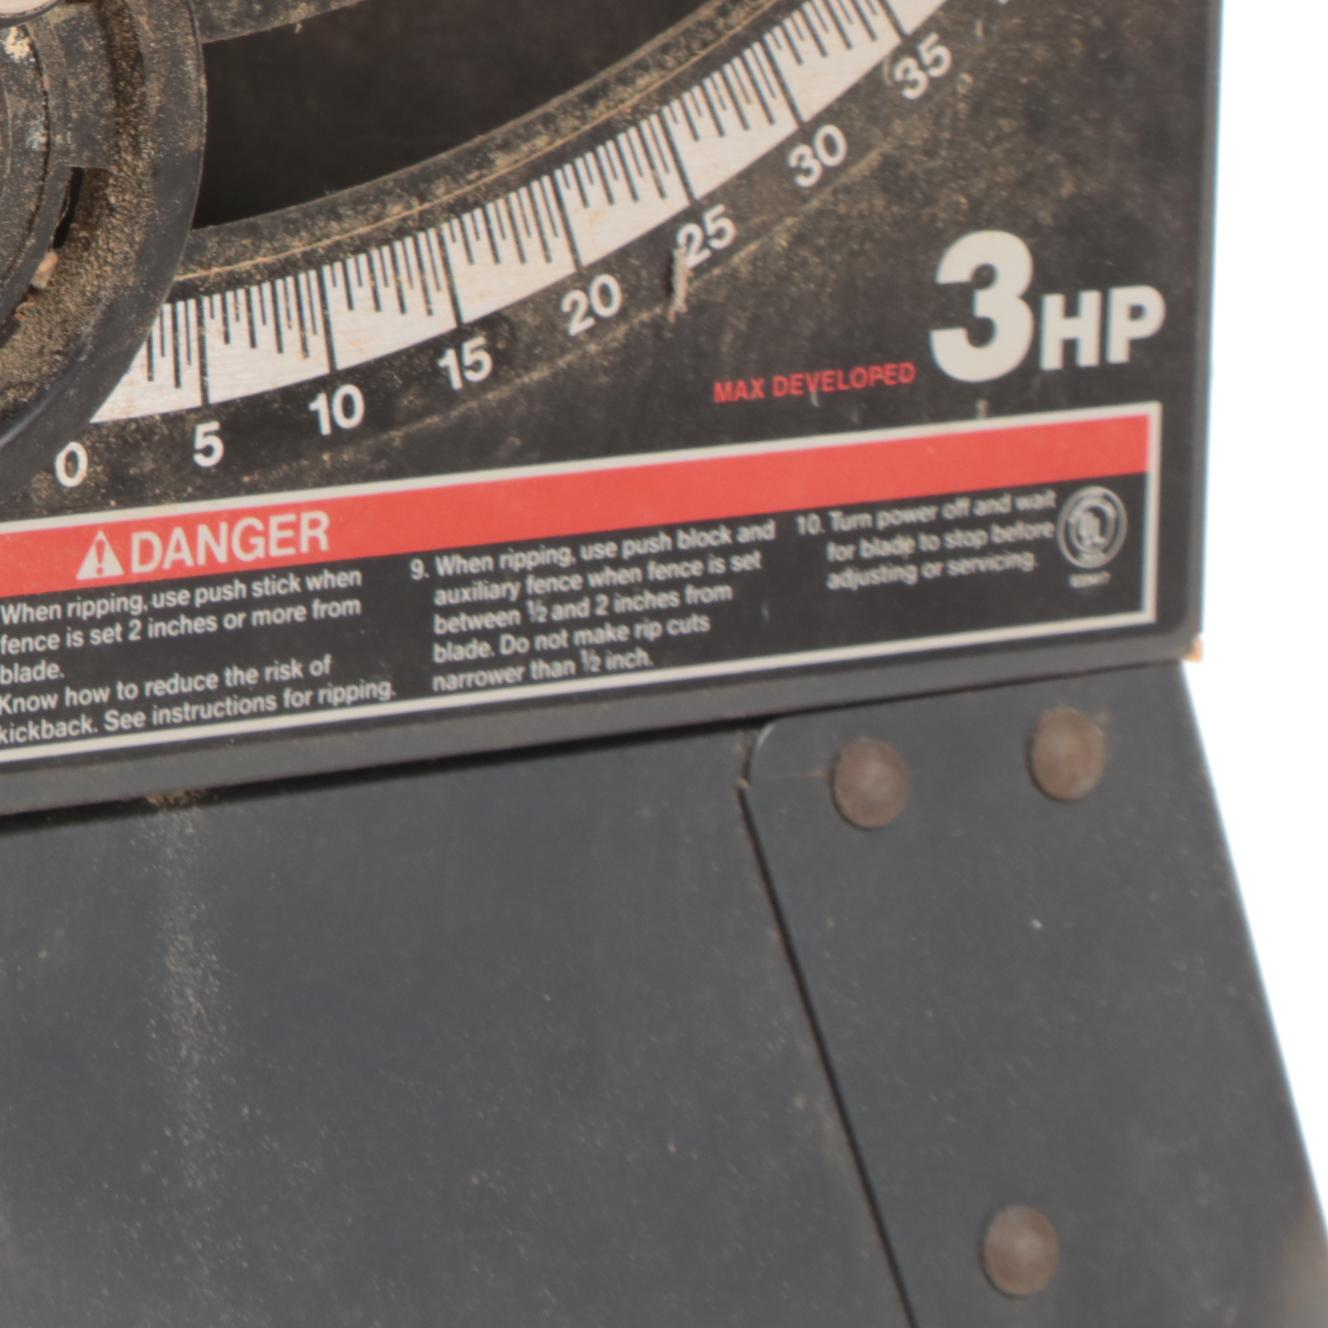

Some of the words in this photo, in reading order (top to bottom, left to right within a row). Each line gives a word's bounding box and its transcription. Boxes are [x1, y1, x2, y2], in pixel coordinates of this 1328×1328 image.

[893, 32, 952, 100] 35
[788, 124, 848, 187] 30
[674, 205, 737, 271] 25
[560, 274, 622, 337] 20
[437, 346, 494, 391] 15
[713, 379, 765, 404] MAX
[772, 361, 916, 397] DEVELOPED
[309, 383, 366, 436] 10
[54, 441, 89, 487] 0
[192, 421, 225, 468] 5
[797, 515, 825, 535] 10.
[830, 510, 872, 531] Turn
[877, 504, 939, 529] power
[972, 494, 1012, 516] and
[1016, 488, 1056, 510] wait
[130, 511, 329, 573] DANGER
[410, 560, 429, 580] 9.
[435, 554, 493, 578] When
[499, 546, 576, 573] ripping,
[581, 542, 618, 561] use
[622, 533, 672, 560] push
[677, 525, 733, 550] block
[737, 520, 775, 543] and
[860, 535, 915, 559] blade
[991, 520, 1055, 543] before
[1, 601, 62, 625] When
[67, 591, 148, 620] ripping,
[151, 586, 191, 609] use
[195, 580, 247, 608] push
[252, 572, 301, 597] stick
[306, 569, 361, 591] when
[434, 579, 521, 606] auxiliary
[526, 572, 582, 595] fence
[588, 566, 642, 588] when
[647, 559, 703, 582] fence
[709, 557, 726, 575] is
[732, 552, 762, 571] set
[826, 564, 917, 590] adjusting
[0, 629, 60, 655] fence
[66, 626, 85, 647] is
[90, 622, 123, 645] set
[128, 619, 142, 640] 2
[147, 611, 217, 639] inches
[223, 610, 246, 630] or
[252, 603, 307, 626] more
[312, 597, 361, 619] from
[434, 608, 521, 635] between
[551, 596, 590, 620] and
[595, 595, 609, 616] 2
[614, 587, 680, 613] inches
[685, 585, 733, 606] from
[434, 639, 495, 664] blade.
[500, 634, 529, 656] Do
[535, 629, 569, 650] not
[574, 622, 629, 645] make
[635, 619, 662, 641] rip
[667, 616, 710, 635] cuts
[0, 661, 64, 685] blade.
[65, 684, 110, 707] how
[117, 680, 138, 700] to
[144, 671, 218, 699] reduce
[225, 664, 259, 687] the
[265, 658, 304, 682] risk
[309, 655, 332, 676] of
[433, 663, 524, 692] narrower
[531, 658, 575, 680] than
[605, 646, 653, 670] inch.
[104, 708, 146, 733] See
[153, 693, 276, 724] instructions
[282, 686, 313, 709] for
[318, 679, 396, 708] ripping.
